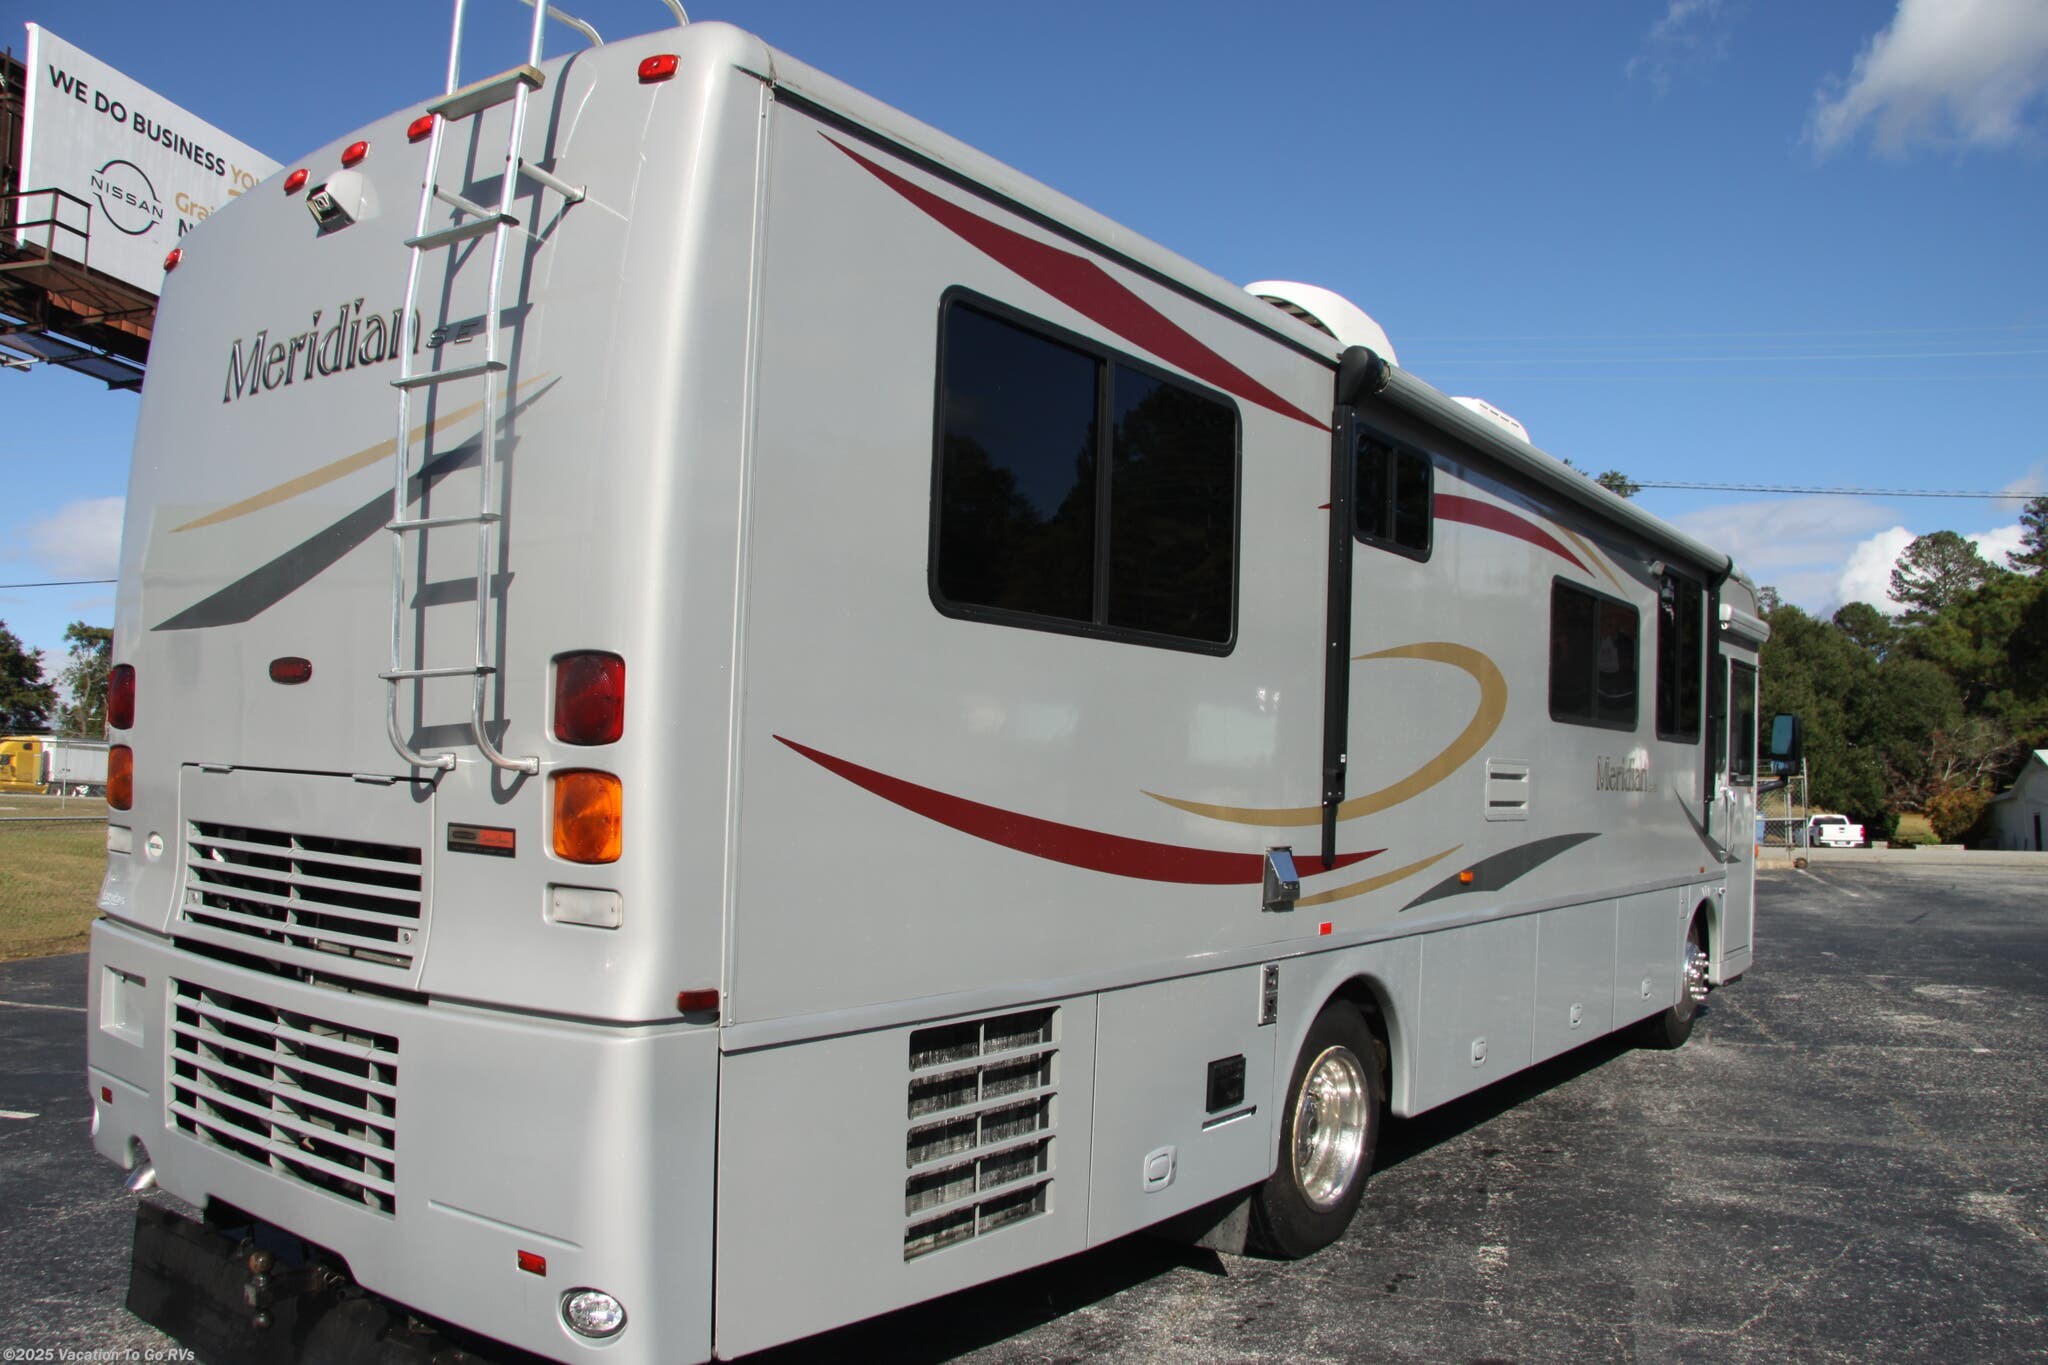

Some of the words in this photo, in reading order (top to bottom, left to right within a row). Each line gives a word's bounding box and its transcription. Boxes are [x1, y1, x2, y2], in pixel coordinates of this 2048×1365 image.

[49, 63, 88, 104] WE
[94, 90, 127, 123] DO
[133, 111, 226, 177] BUSINESS
[91, 174, 163, 219] NISSAN
[223, 298, 421, 404] Meridian
[1596, 755, 1648, 793] Meridian
